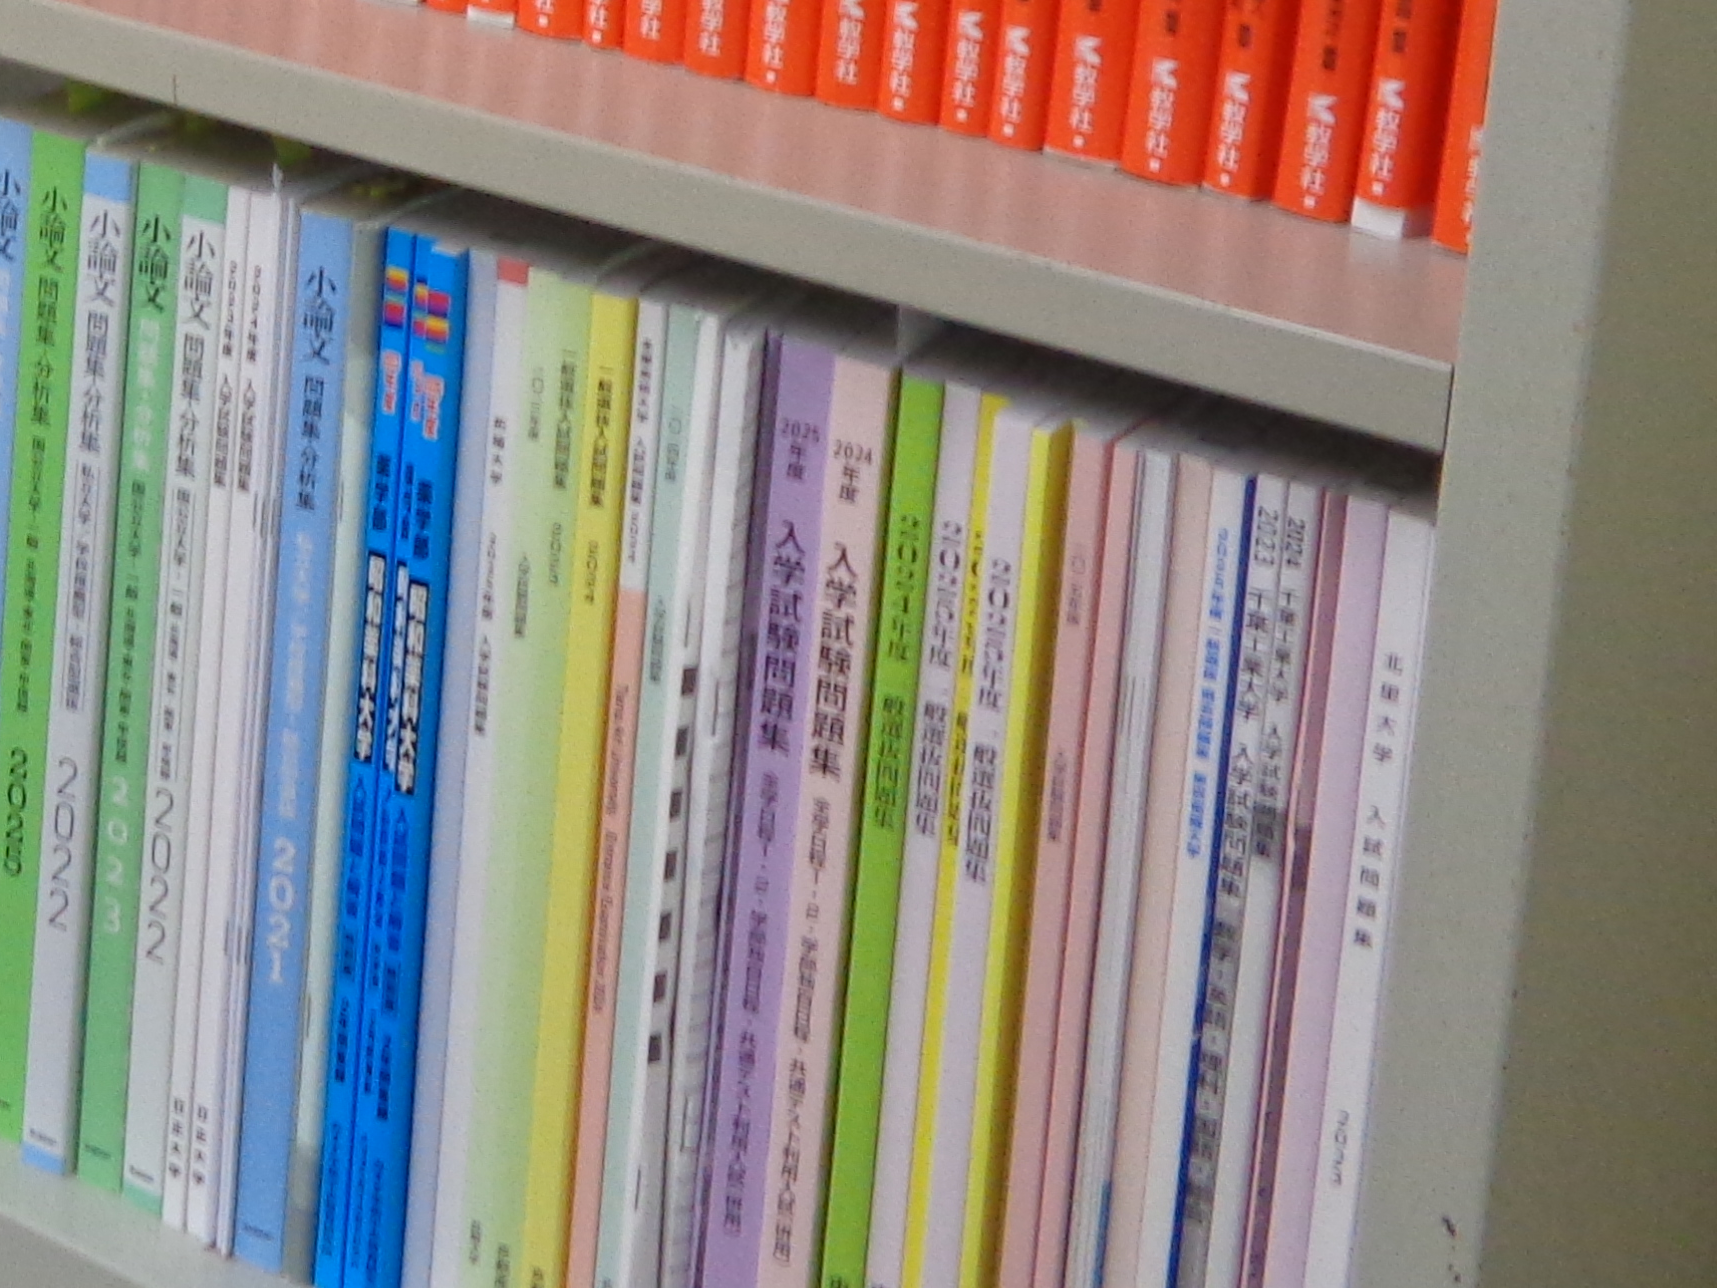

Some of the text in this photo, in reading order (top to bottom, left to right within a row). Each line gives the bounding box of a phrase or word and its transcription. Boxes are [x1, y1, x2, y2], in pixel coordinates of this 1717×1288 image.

[38, 186, 69, 274] 小論文
[87, 208, 122, 310] 小論文
[137, 213, 171, 314] 小論文
[184, 230, 216, 332] 小論文
[755, 519, 809, 757] 入学試験問題集
[809, 542, 859, 784] 入学試験問題集
[48, 756, 78, 931] 2022
[145, 787, 174, 966] 2022
